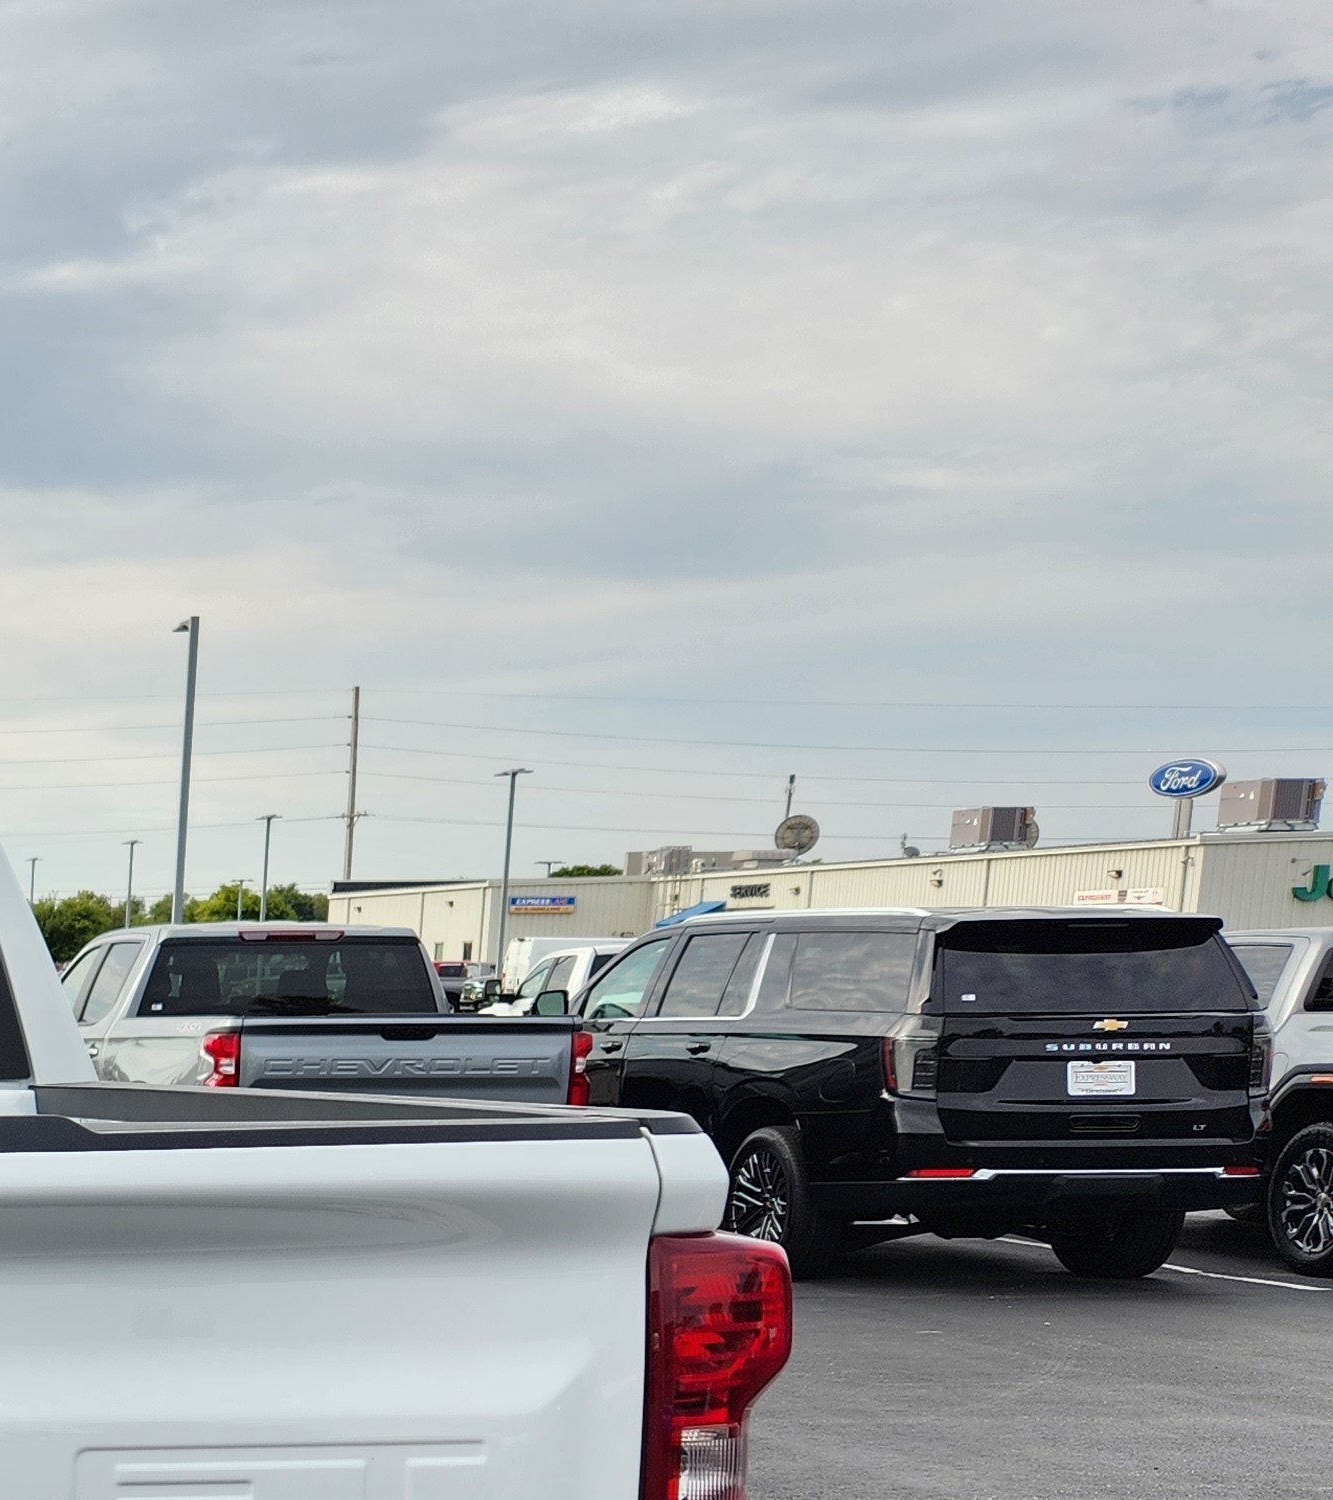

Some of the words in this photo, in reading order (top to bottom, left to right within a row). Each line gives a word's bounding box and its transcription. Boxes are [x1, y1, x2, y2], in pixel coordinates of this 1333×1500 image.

[1160, 765, 1202, 791] Ford
[1045, 1042, 1171, 1052] SUBURBAN
[263, 1057, 550, 1075] CHEVROLET
